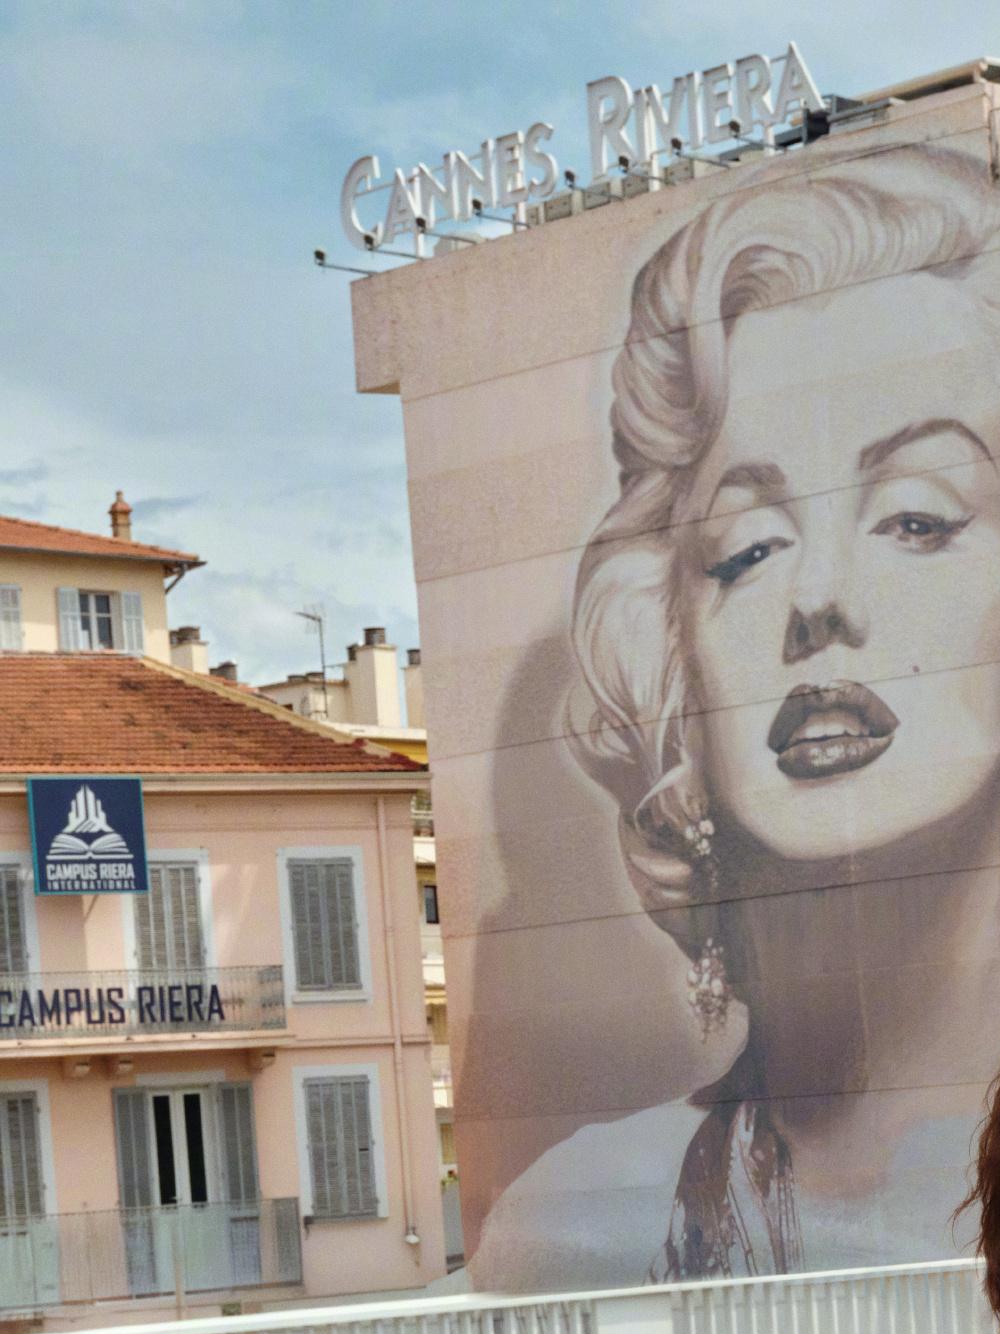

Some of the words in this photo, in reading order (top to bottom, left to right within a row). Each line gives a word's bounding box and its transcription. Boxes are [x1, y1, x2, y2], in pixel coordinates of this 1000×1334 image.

[340, 122, 559, 249] CANNES
[586, 41, 826, 181] RIVIERA
[46, 863, 98, 880] CAMPUS
[99, 863, 135, 880] RIERA
[47, 880, 136, 890] INTERNATIONAL
[0, 987, 126, 1028] CAMPUS
[137, 984, 226, 1024] RIERA
